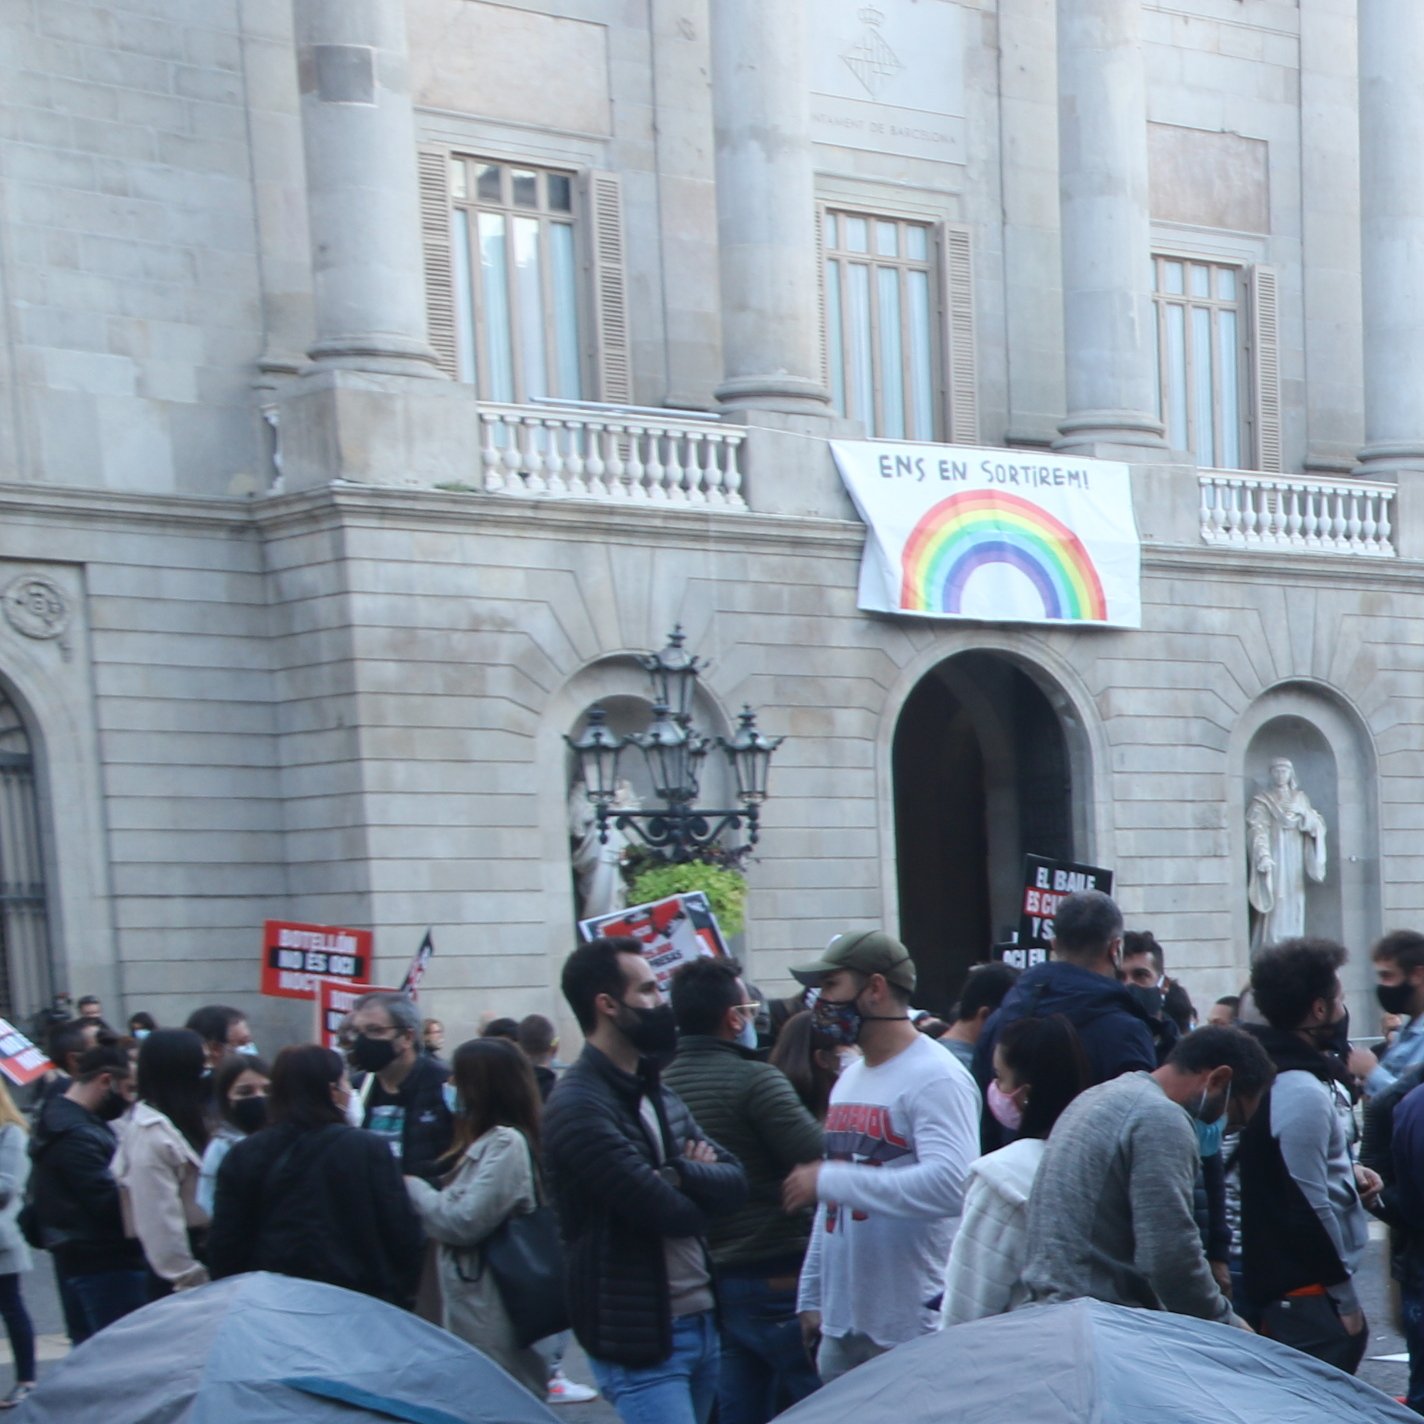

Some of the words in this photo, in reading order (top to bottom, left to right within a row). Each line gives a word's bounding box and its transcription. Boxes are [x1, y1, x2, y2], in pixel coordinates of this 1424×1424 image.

[878, 454, 926, 482] ENS
[938, 459, 968, 481] EN
[1036, 866, 1050, 889] EL
